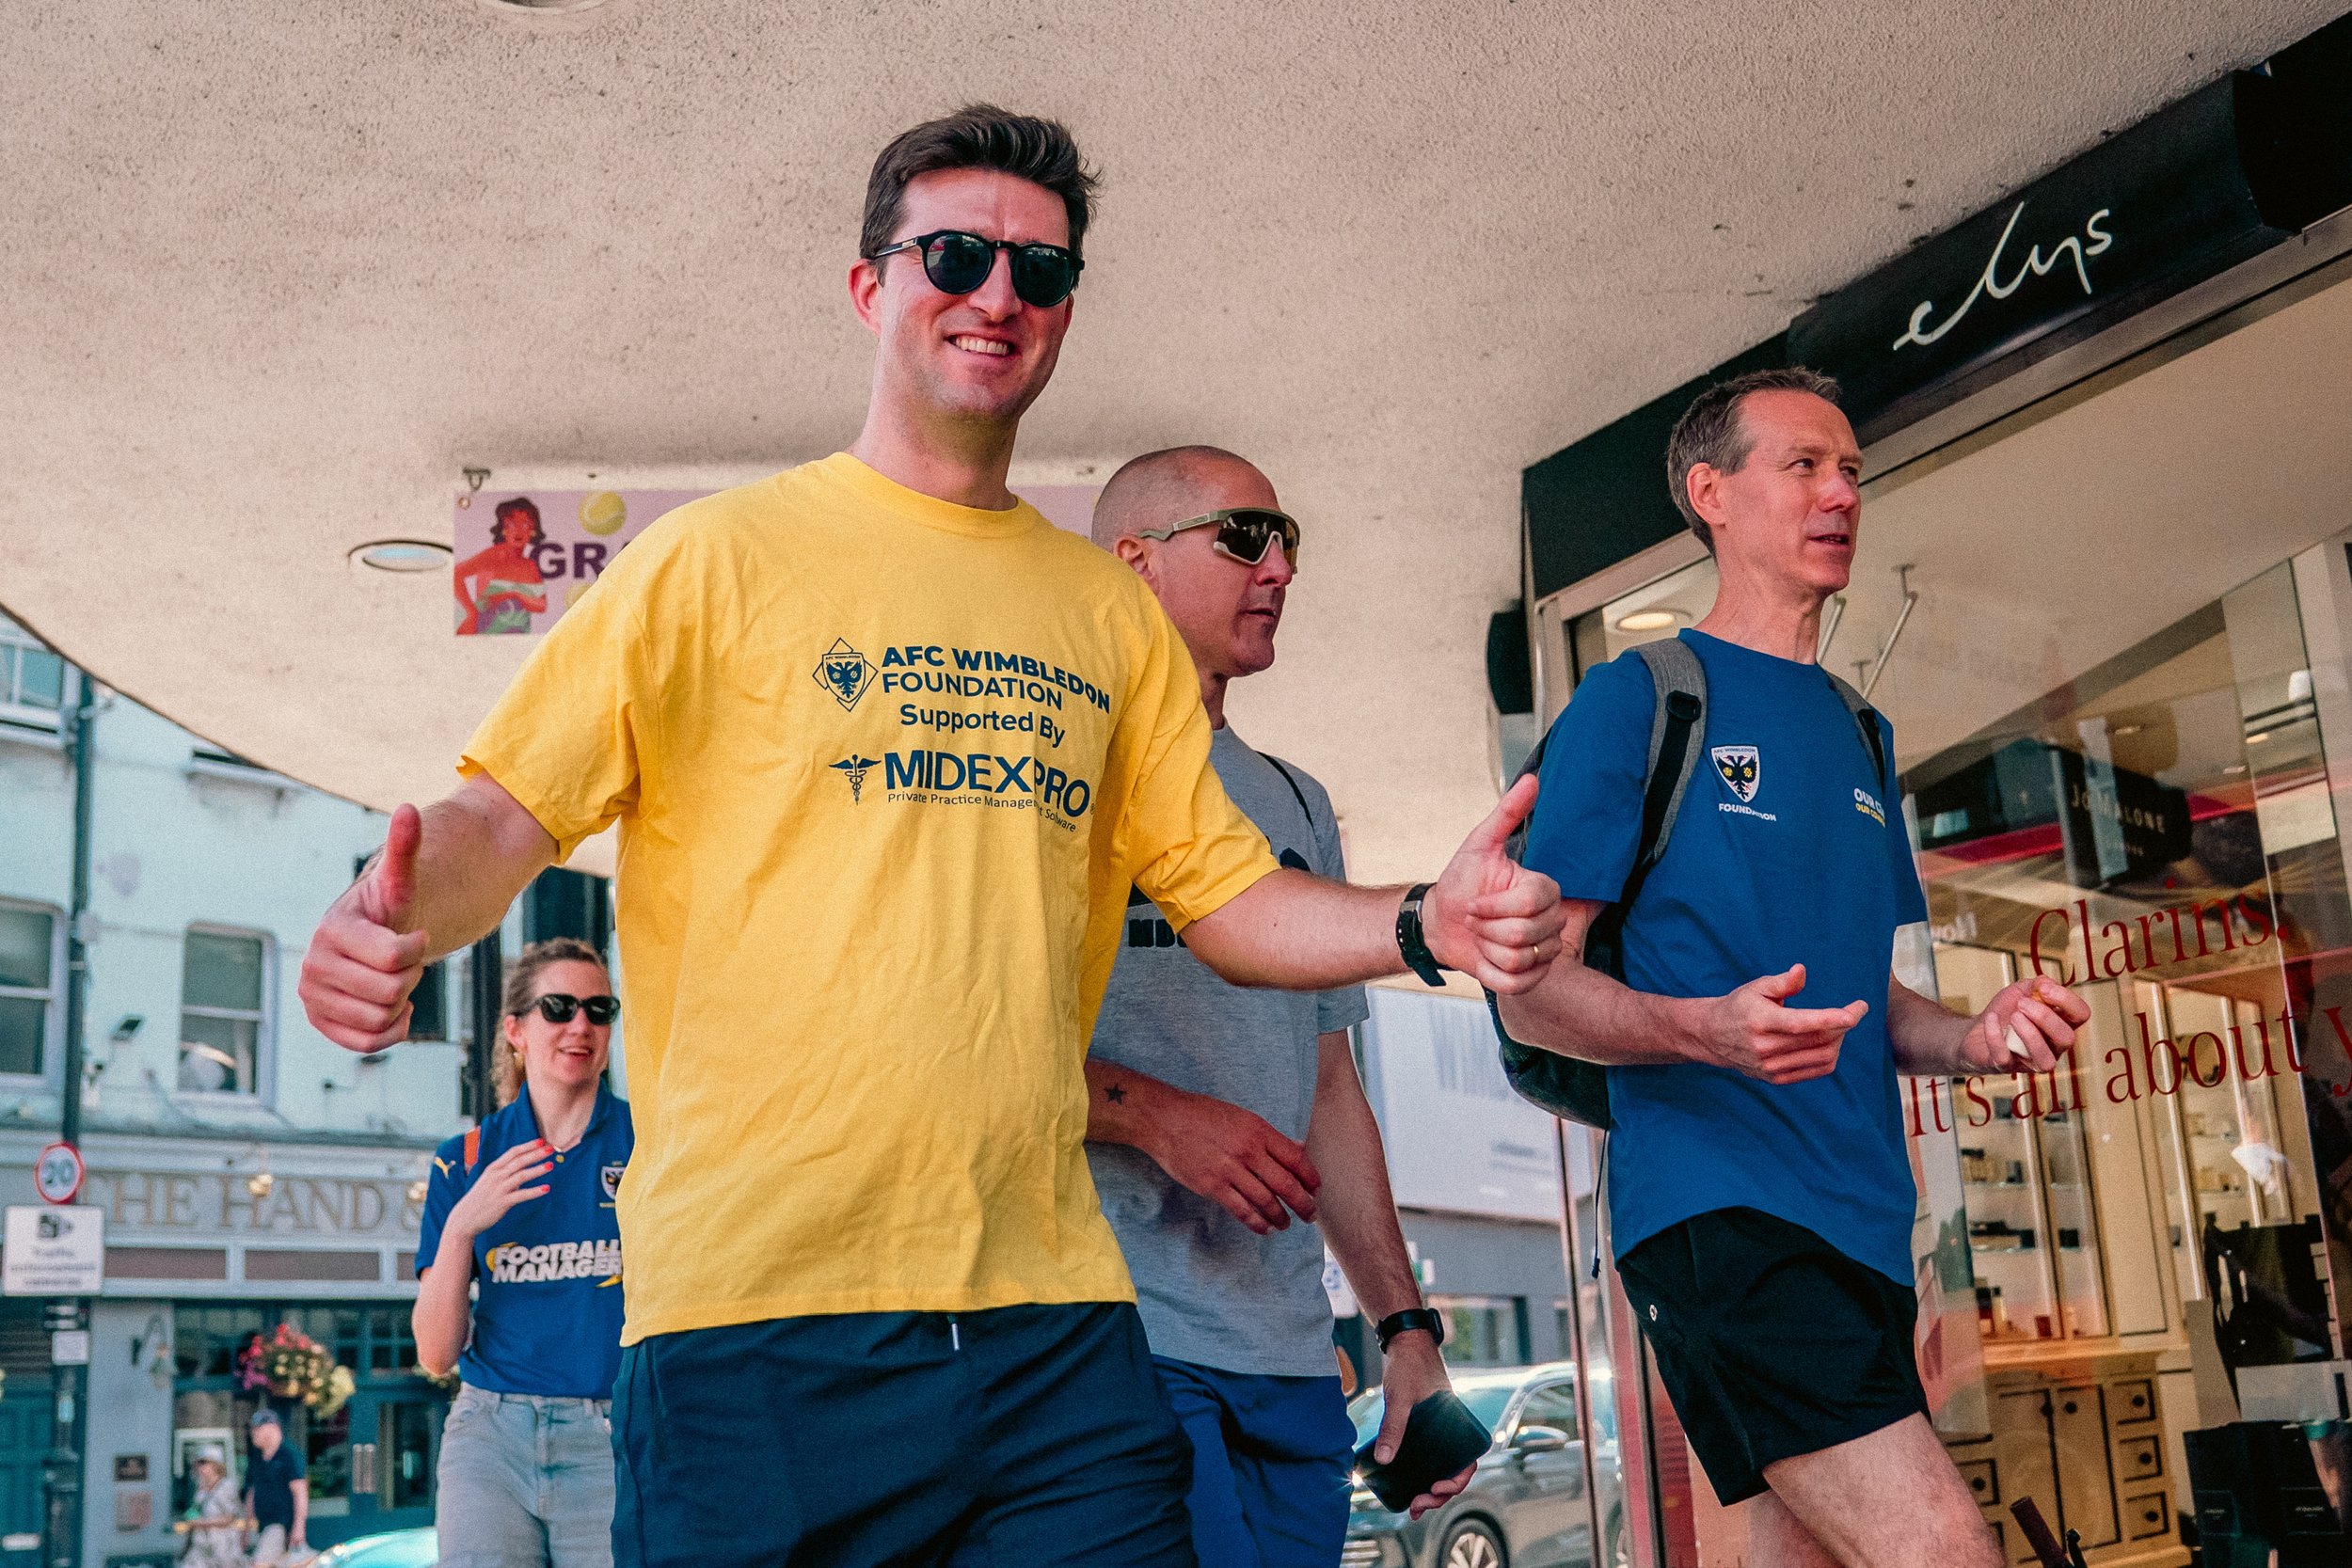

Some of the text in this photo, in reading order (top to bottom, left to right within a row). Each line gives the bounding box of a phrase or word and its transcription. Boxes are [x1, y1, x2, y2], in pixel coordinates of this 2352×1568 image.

[532, 542, 631, 579] GR
[882, 645, 1110, 714] AFC WIMBLEDON
[882, 671, 1062, 711] FOUNDATION
[900, 704, 1066, 748] Supported By
[884, 750, 1090, 817] MIDEXPRO
[887, 790, 928, 803] Private
[930, 793, 982, 806] Practice
[2029, 878, 2288, 988] Clarins.
[1909, 1074, 1992, 1136] Its
[2105, 1001, 2309, 1104] about
[221, 1174, 388, 1231] HAND
[491, 1257, 622, 1283] MANAGER
[494, 1239, 621, 1265] FOOTBALL
